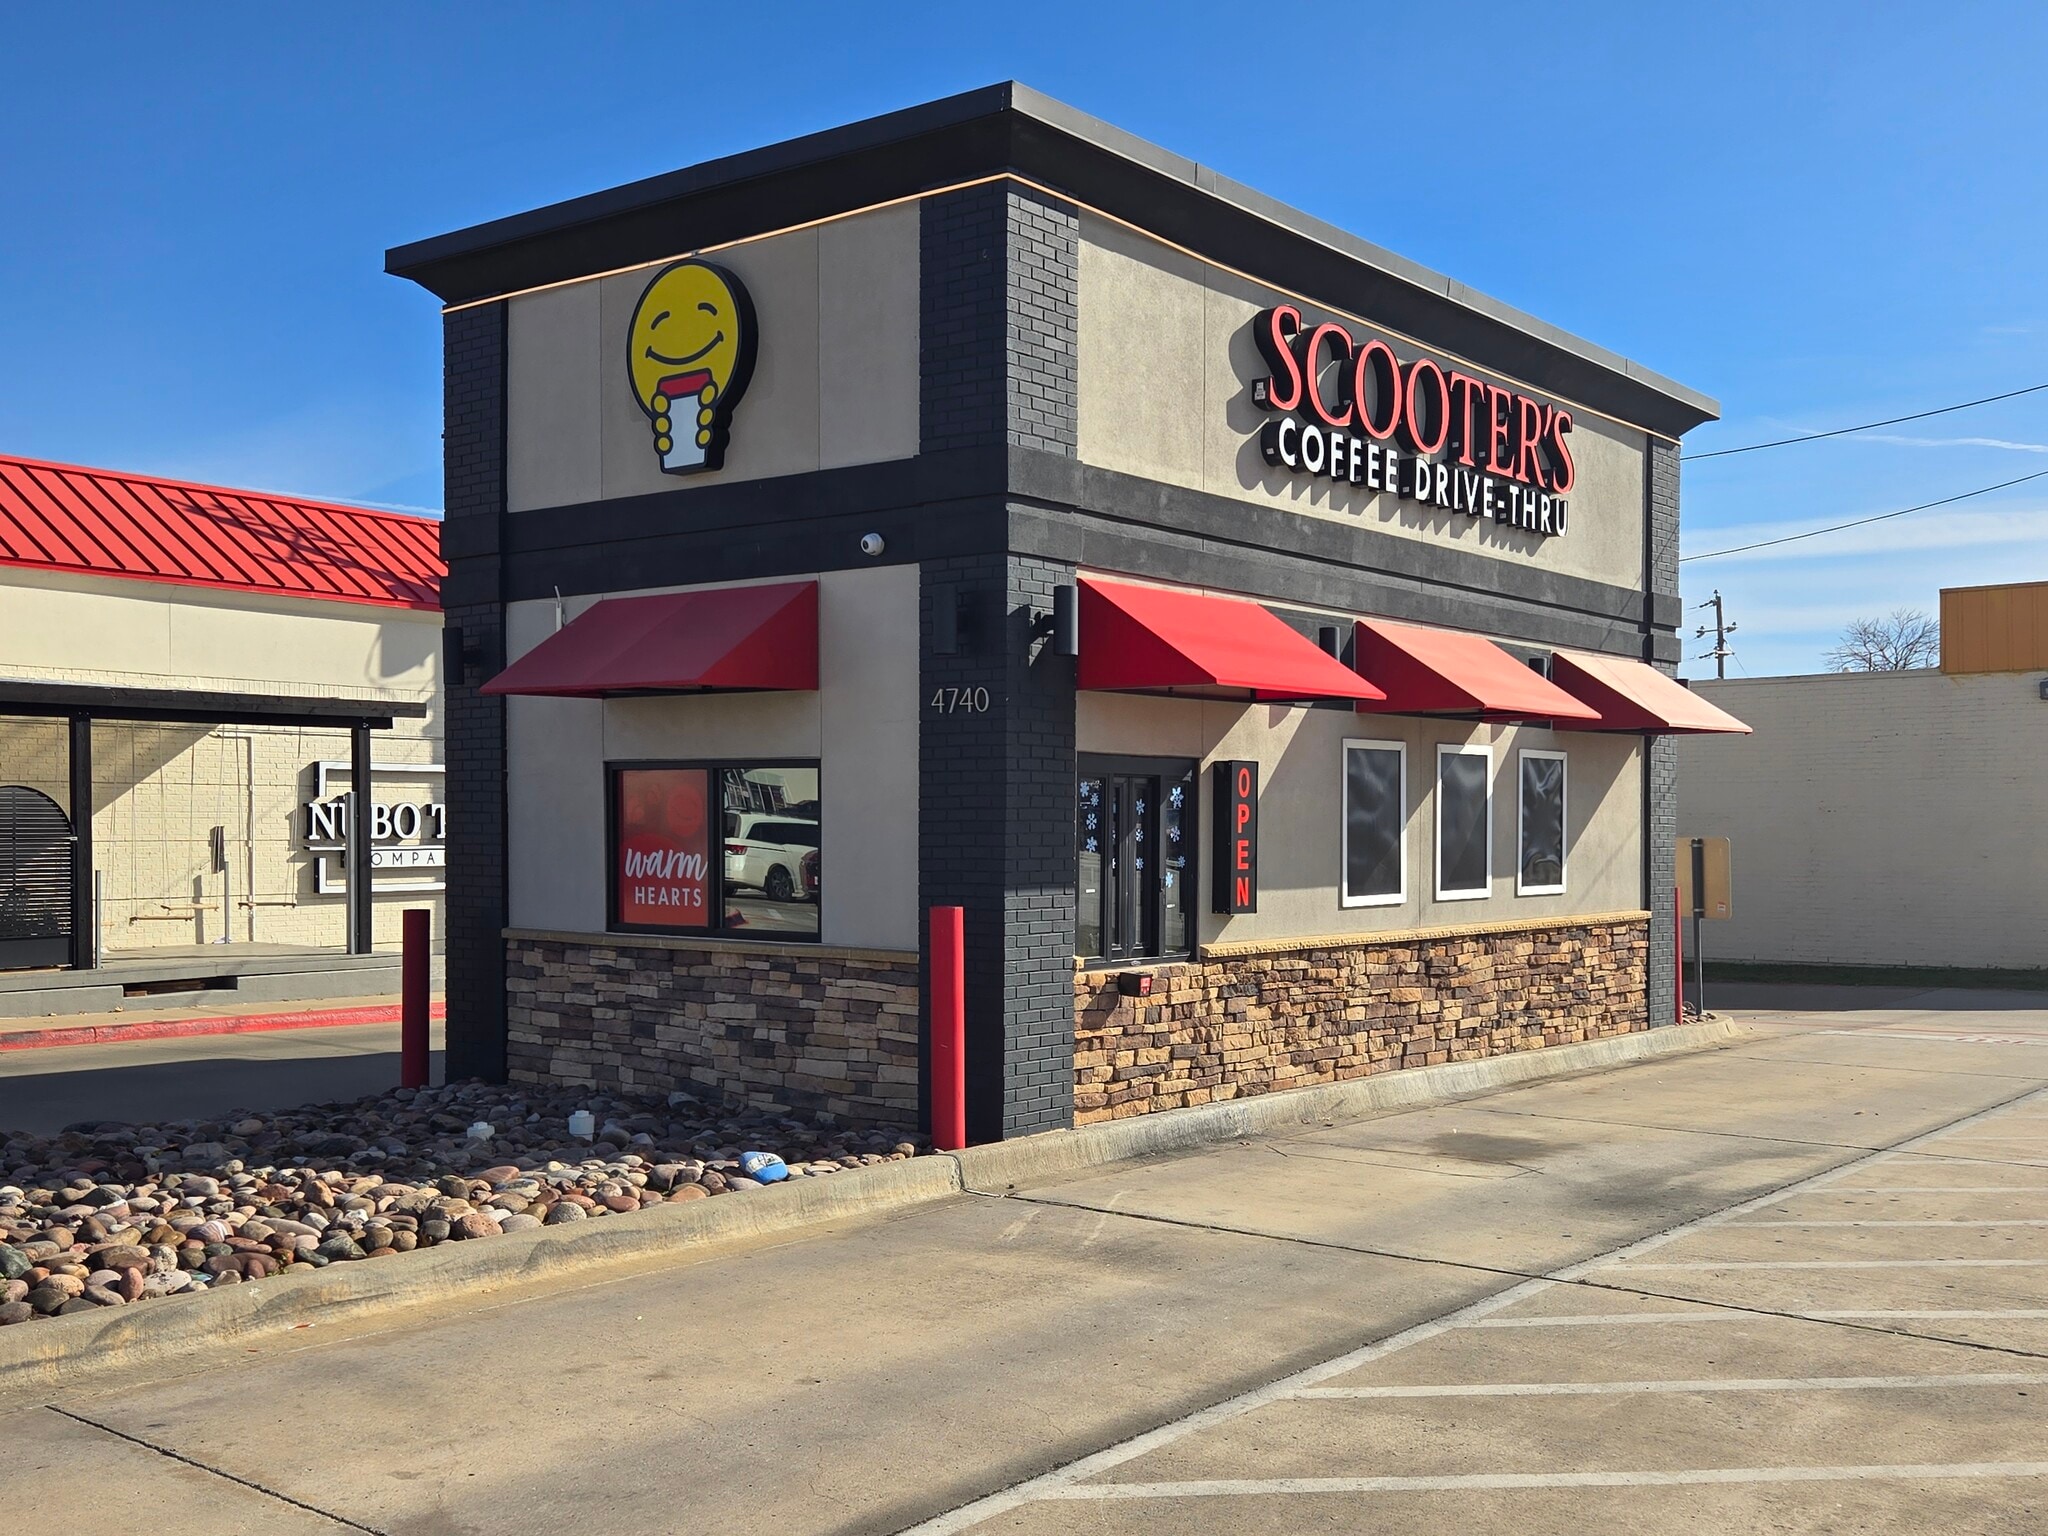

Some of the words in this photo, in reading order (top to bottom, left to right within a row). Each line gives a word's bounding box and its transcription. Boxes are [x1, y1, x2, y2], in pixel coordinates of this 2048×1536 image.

[1269, 304, 1575, 495] SCOOTER'S
[1278, 417, 1398, 494] COFFEE
[1415, 457, 1569, 537] DRIVE-THRU
[931, 686, 989, 714] 4740
[1236, 767, 1251, 907] OPEN
[371, 851, 436, 866] OMPA
[625, 848, 708, 881] warm
[635, 886, 702, 907] HEARTS
